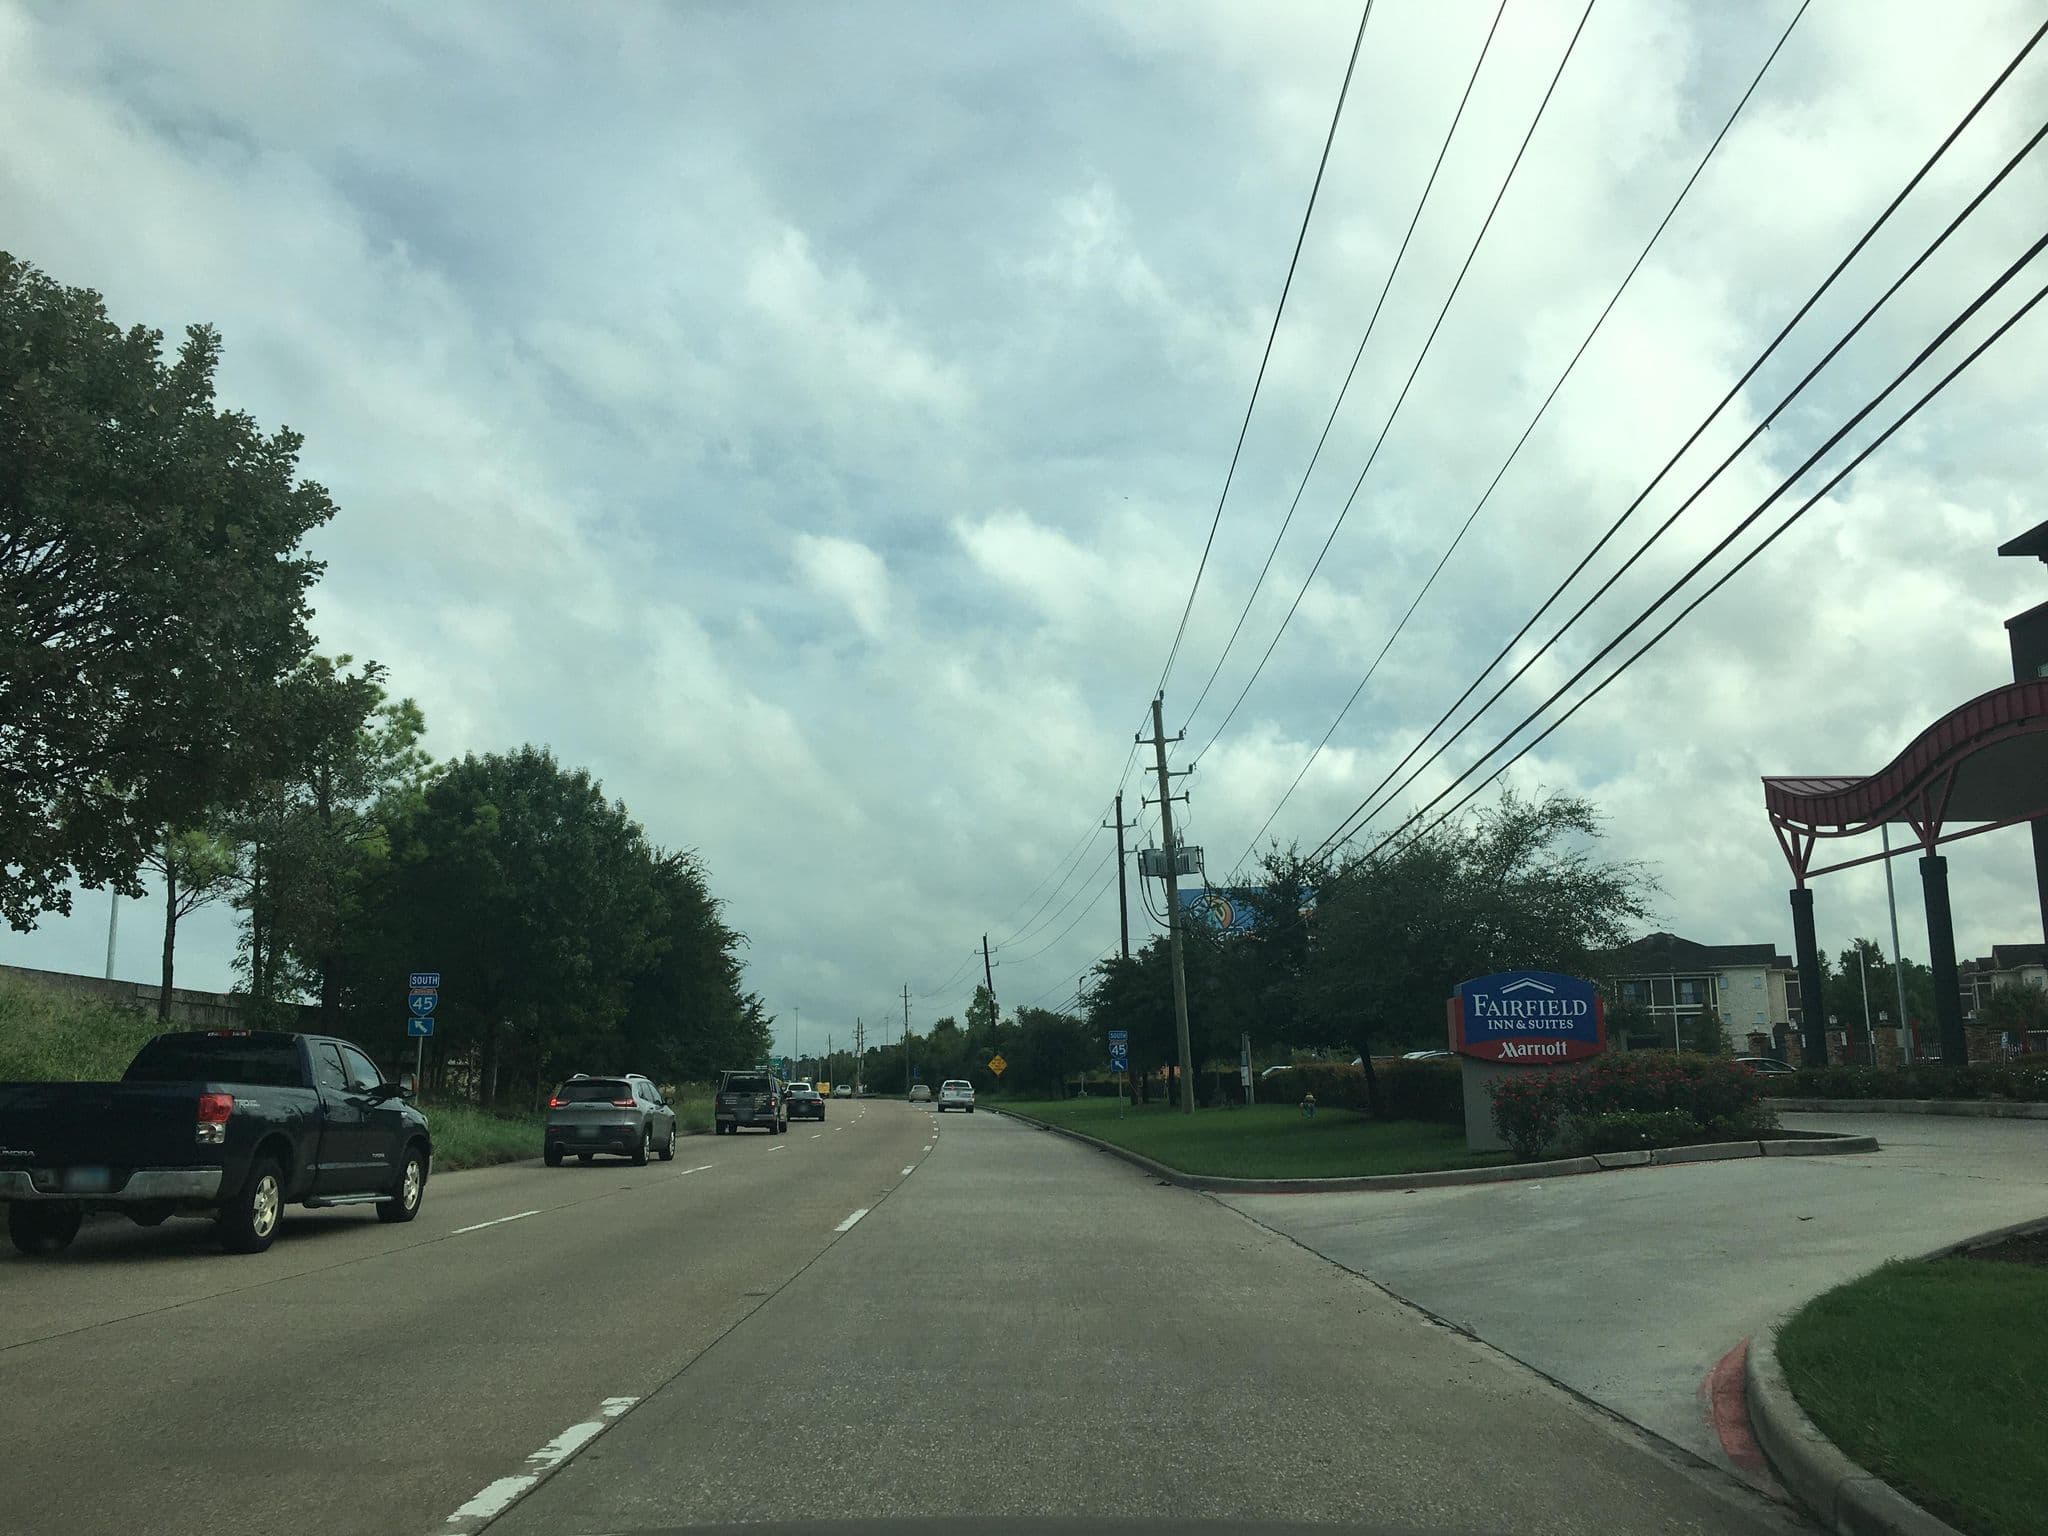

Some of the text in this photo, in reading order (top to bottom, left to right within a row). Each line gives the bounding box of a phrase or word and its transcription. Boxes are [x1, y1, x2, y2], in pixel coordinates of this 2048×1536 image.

[411, 975, 438, 985] SOUTH
[412, 997, 434, 1010] 45
[1472, 994, 1588, 1019] FAIRFIELD
[1487, 1019, 1575, 1030] INN & SUITES
[1111, 1044, 1126, 1056] 45
[1498, 1041, 1568, 1059] Marriott
